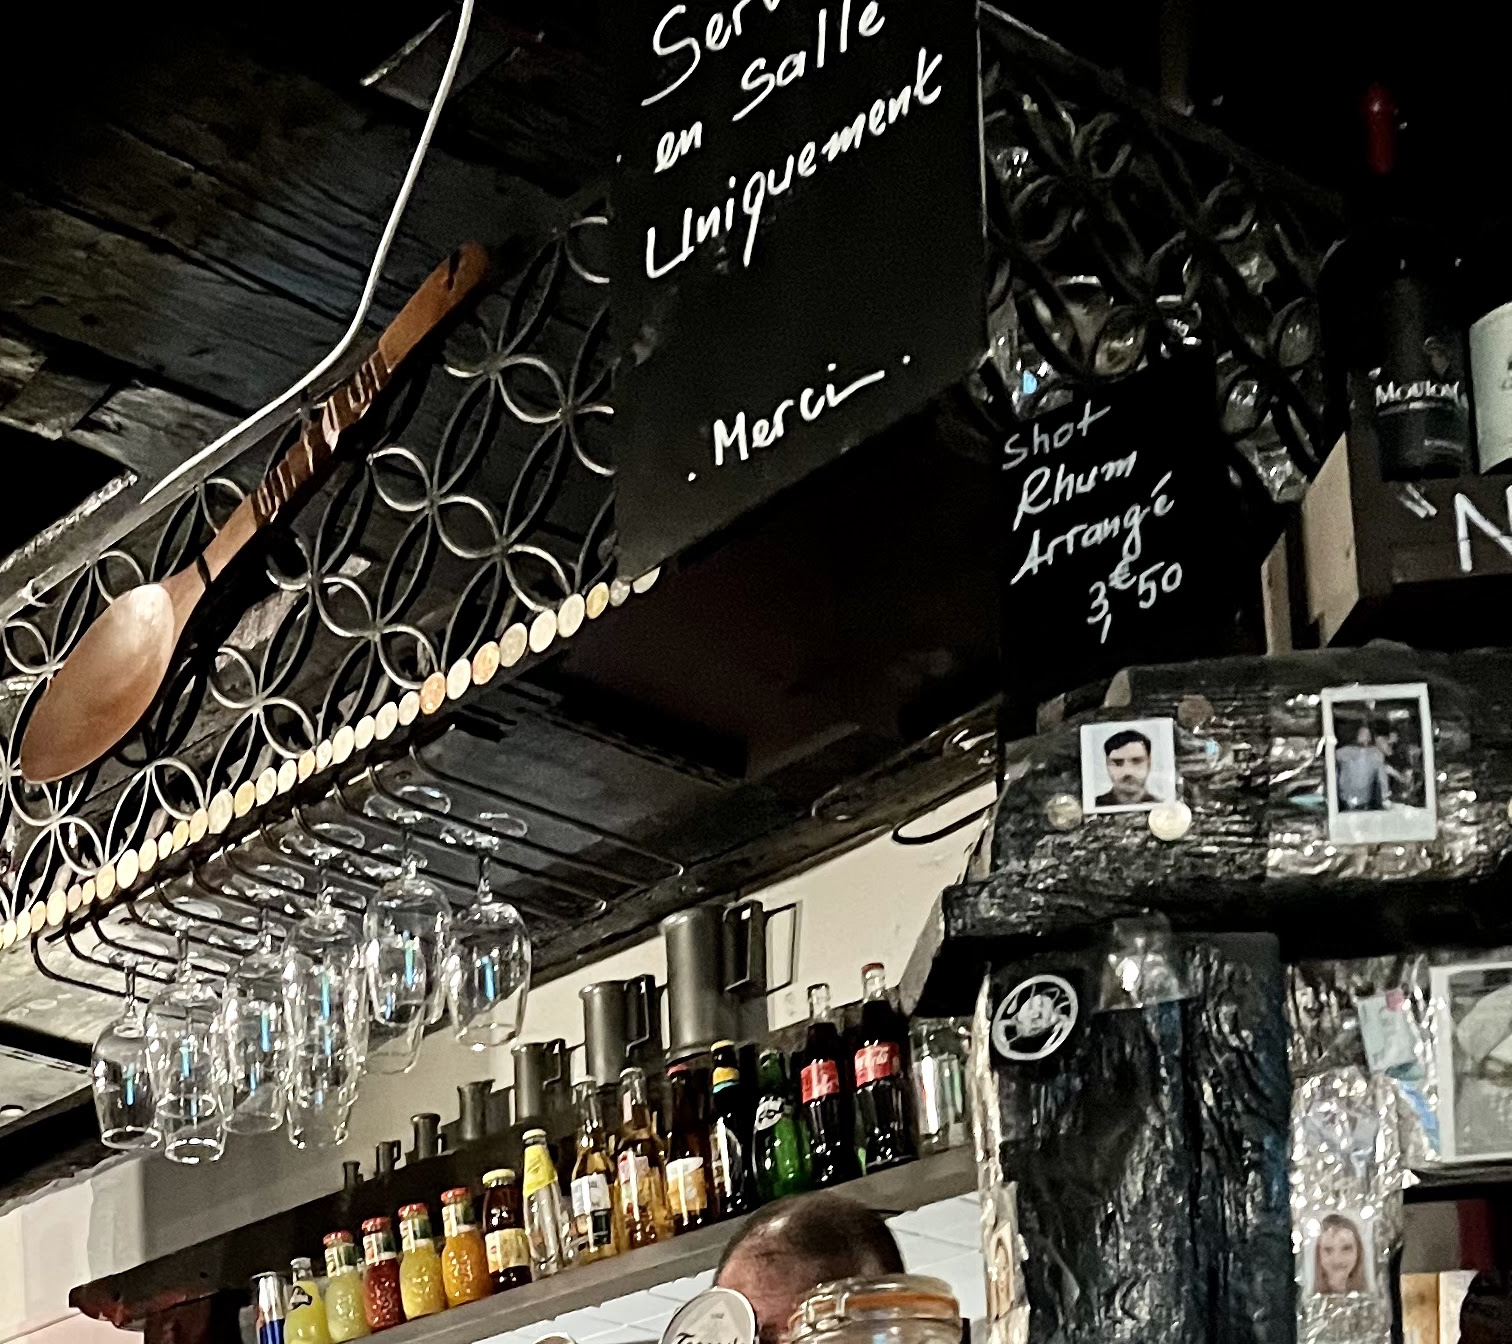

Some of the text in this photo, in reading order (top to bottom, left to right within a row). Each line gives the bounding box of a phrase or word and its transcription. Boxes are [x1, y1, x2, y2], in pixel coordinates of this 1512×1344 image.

[646, 47, 943, 279] Uniquement
[654, 121, 703, 174] en
[713, 362, 886, 466] Merci
[1002, 400, 1111, 471] Shot
[1010, 470, 1175, 585] Arrangé
[1013, 451, 1137, 532] Rhum
